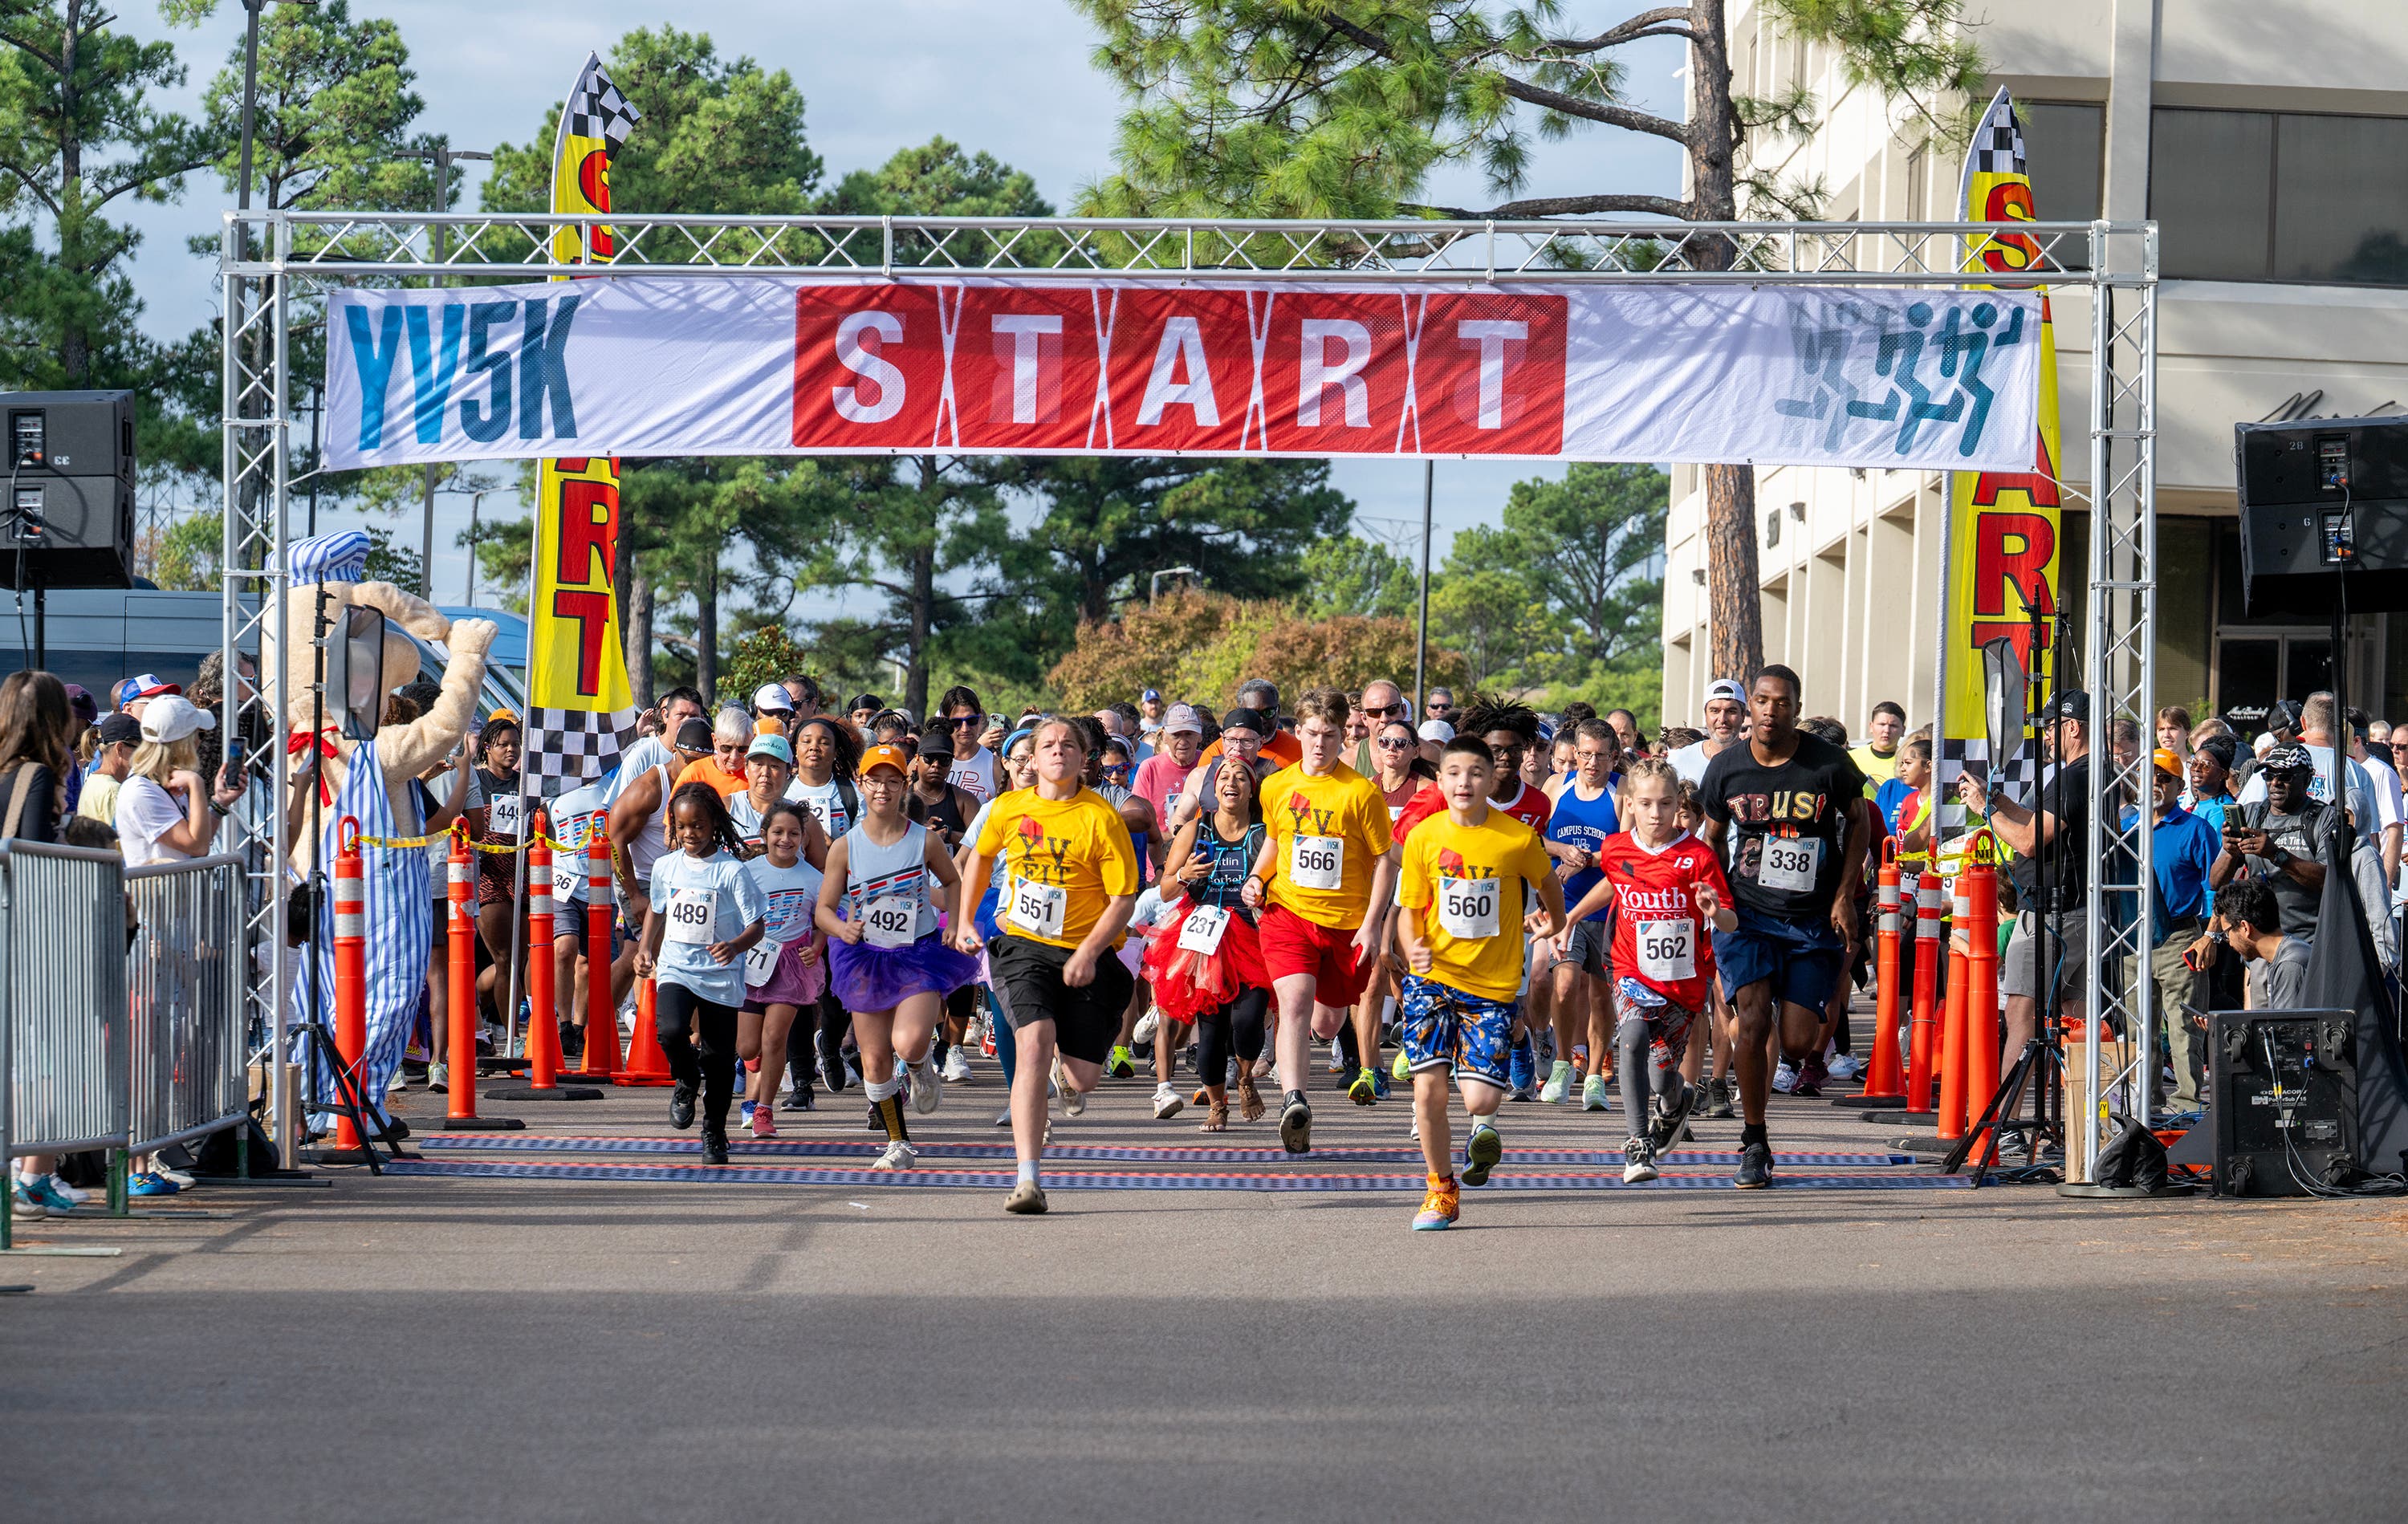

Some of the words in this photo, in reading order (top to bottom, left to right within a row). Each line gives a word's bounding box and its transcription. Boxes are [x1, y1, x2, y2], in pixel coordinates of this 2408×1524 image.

[344, 295, 580, 450] YV5K
[830, 310, 1530, 430] START
[1557, 825, 1582, 839] CAMPUS
[1298, 849, 1336, 872] 566
[1673, 856, 1694, 870] 19
[1769, 849, 1811, 873] 338
[1019, 892, 1054, 923] 551
[1448, 894, 1491, 918] 560
[1614, 883, 1688, 910] Youth
[673, 902, 708, 925] 489
[869, 909, 909, 933] 492
[1186, 915, 1217, 937] 231
[1645, 936, 1687, 961] 562
